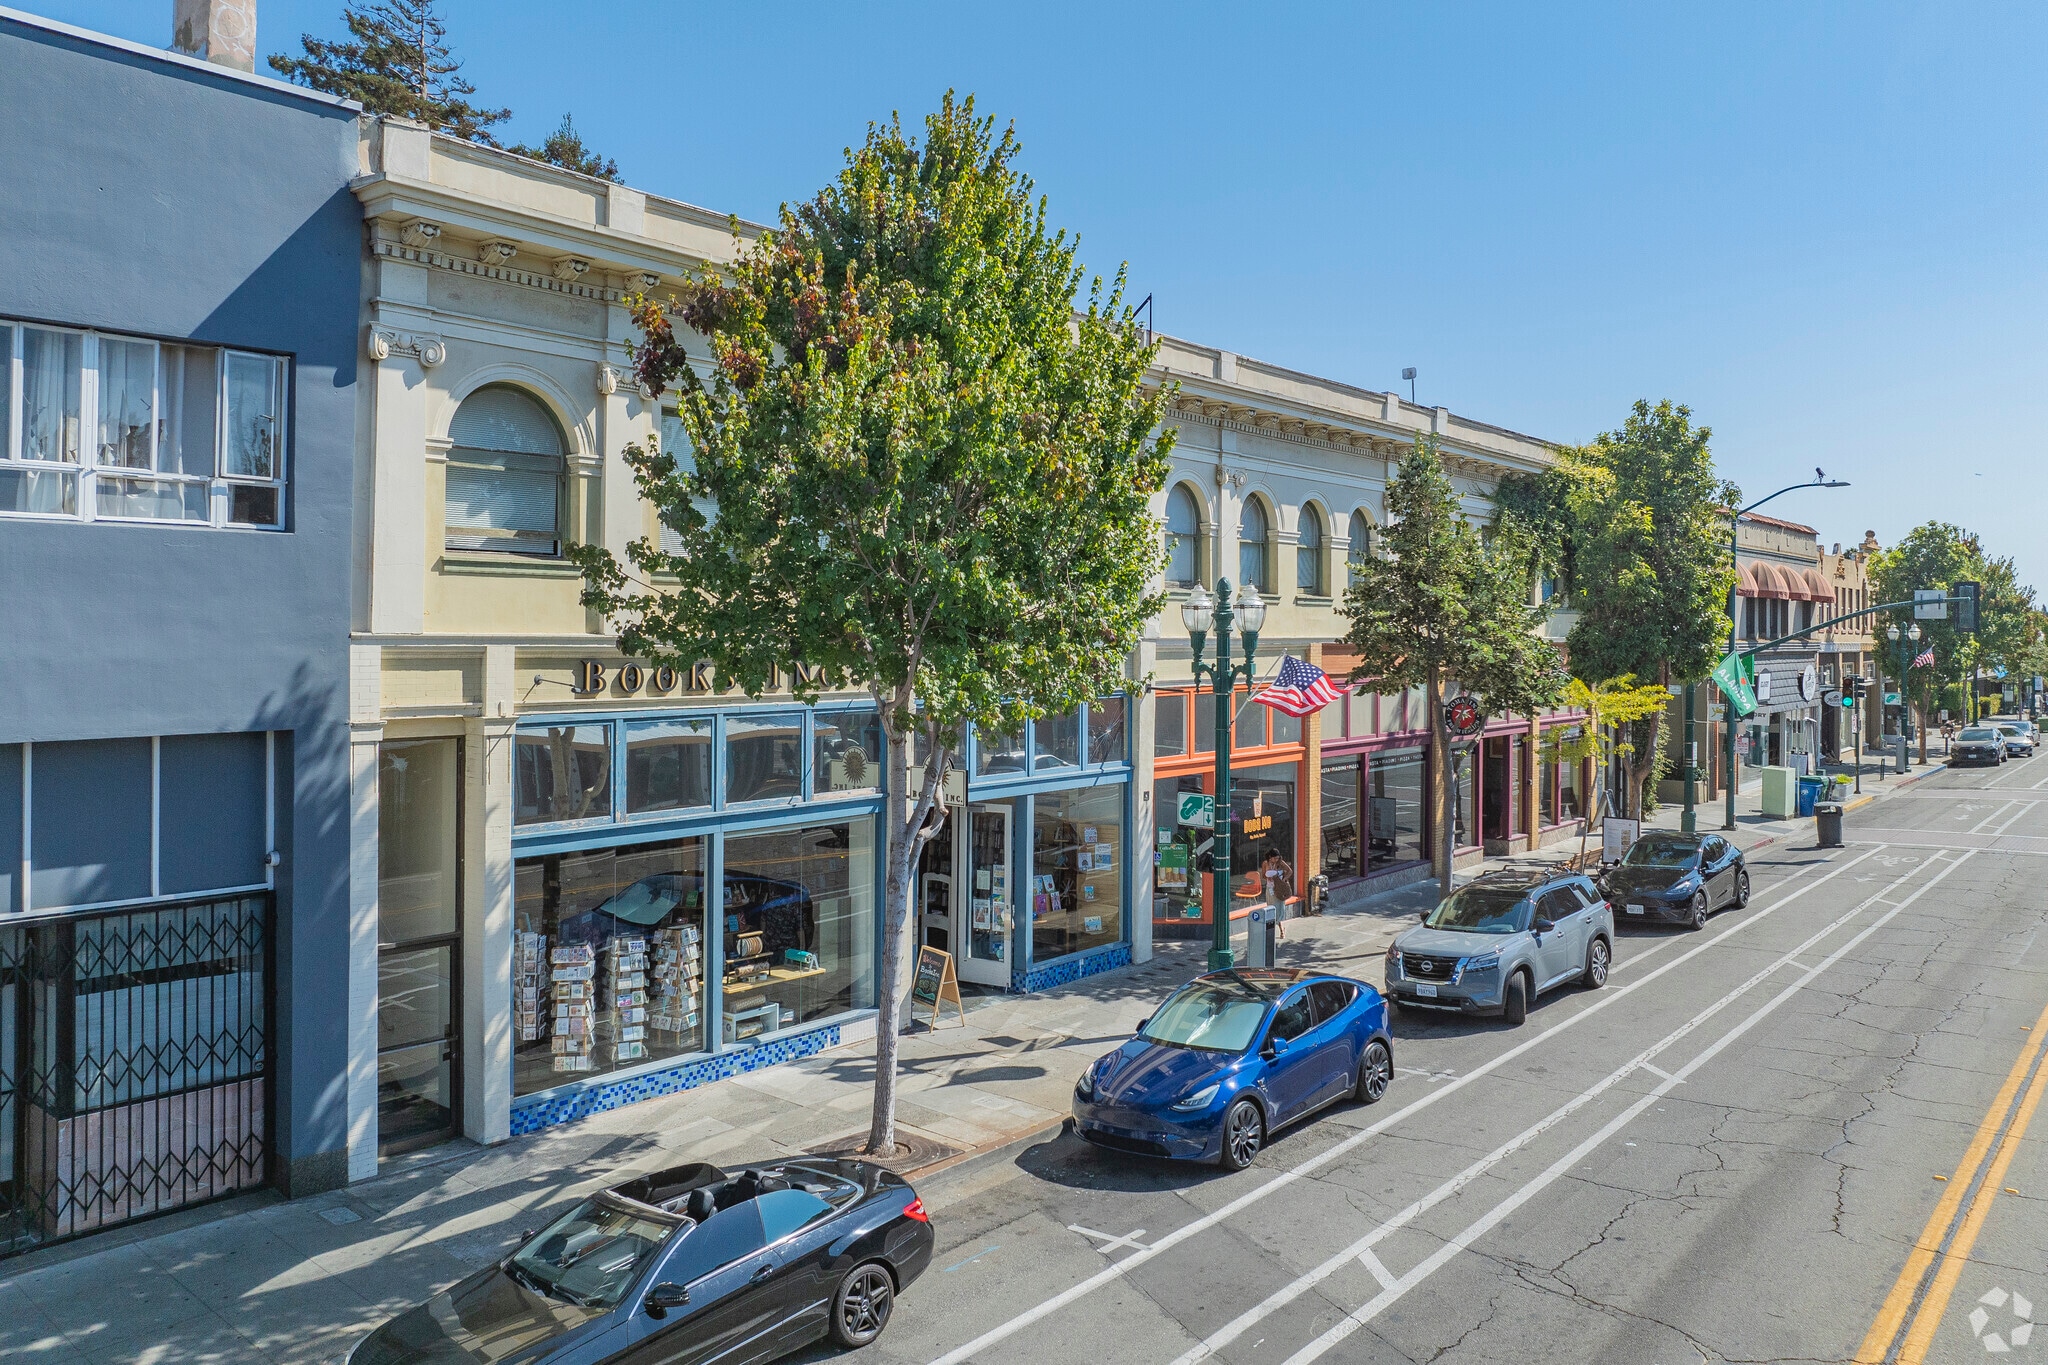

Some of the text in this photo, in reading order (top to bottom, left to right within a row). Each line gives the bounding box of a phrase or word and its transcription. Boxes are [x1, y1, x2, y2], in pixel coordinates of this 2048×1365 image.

[1717, 668, 1752, 710] ALAMEDA
[945, 794, 963, 803] INC.
[1204, 796, 1213, 809] 2
